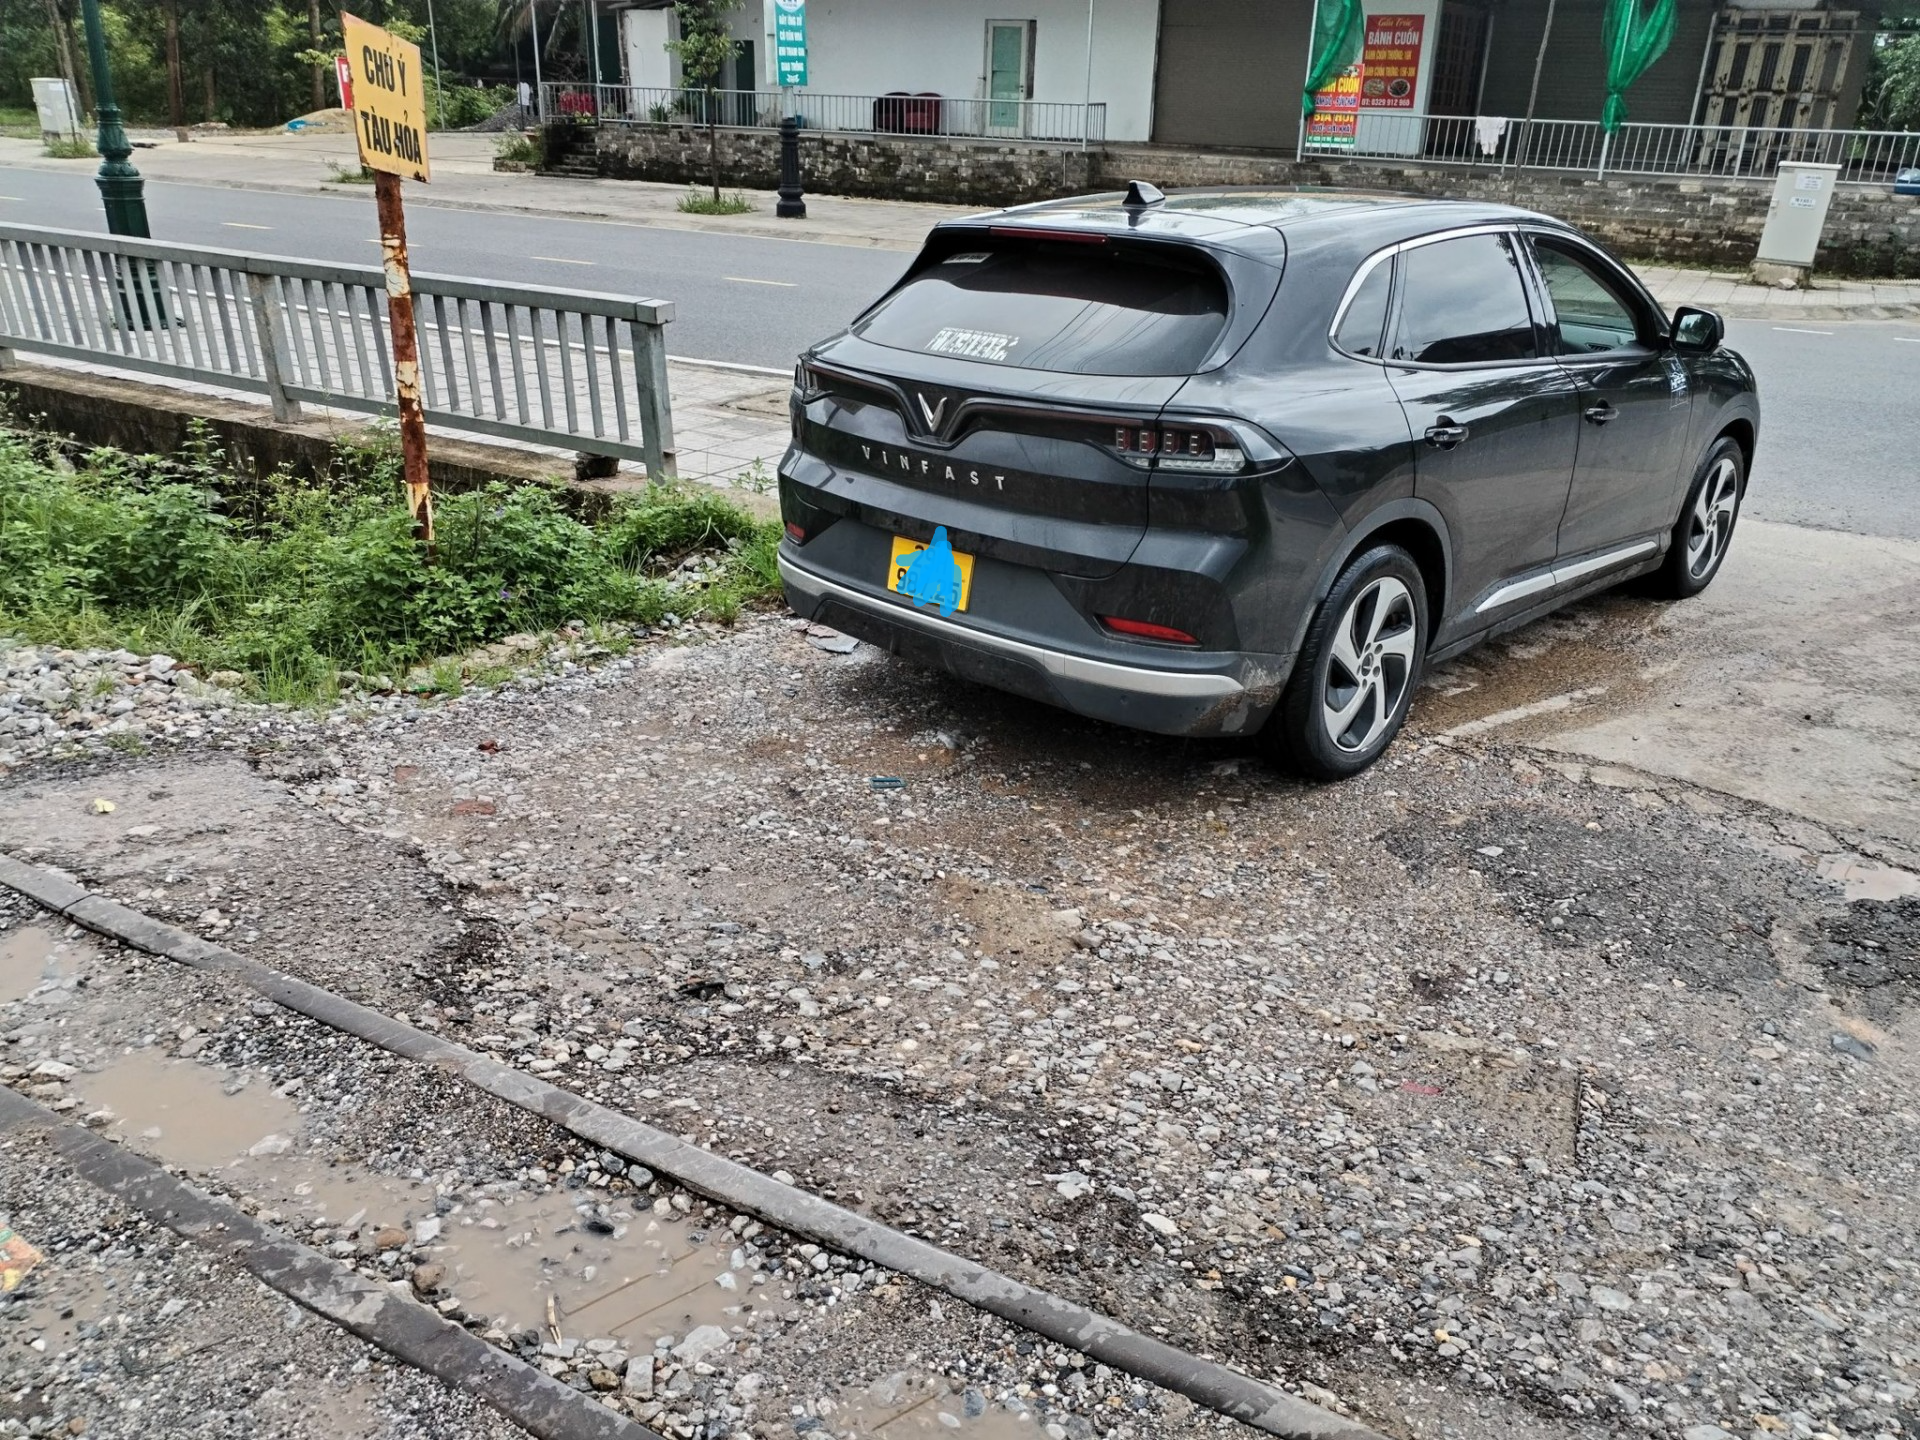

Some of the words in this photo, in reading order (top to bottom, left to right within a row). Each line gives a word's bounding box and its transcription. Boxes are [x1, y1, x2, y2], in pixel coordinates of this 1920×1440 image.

[1368, 29, 1393, 45] BÁNH
[1394, 27, 1420, 45] CUỐN
[362, 45, 396, 93] CHÚ
[397, 53, 407, 97] Ý
[360, 106, 392, 156] TÀU
[393, 109, 423, 165] HỎA
[862, 445, 1005, 490] VINFAST
